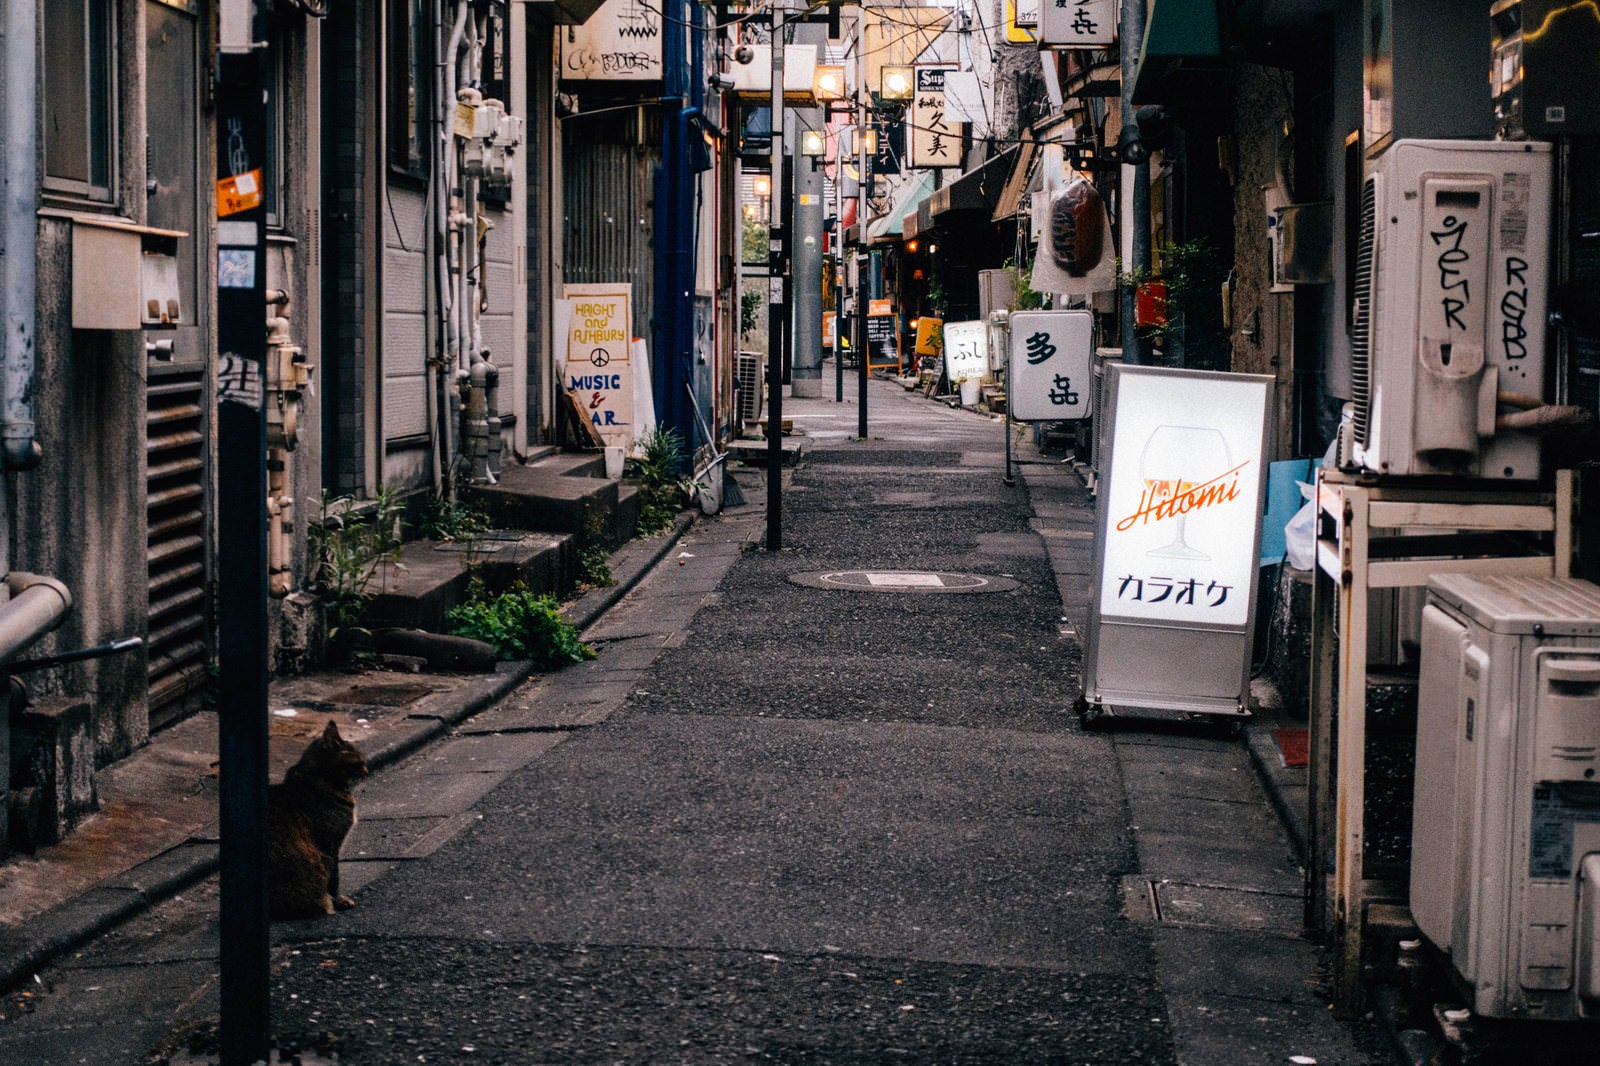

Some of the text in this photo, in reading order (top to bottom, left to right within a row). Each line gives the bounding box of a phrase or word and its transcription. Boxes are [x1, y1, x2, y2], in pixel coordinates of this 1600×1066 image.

[928, 110, 948, 157] 久美
[575, 303, 616, 318] HAIGHT
[584, 317, 609, 328] and
[573, 329, 625, 344] ASHBURY
[571, 374, 621, 390] MUSIC
[589, 391, 606, 409] &
[1117, 460, 1250, 532] Hitomi
[1118, 574, 1234, 607] カラオケ
